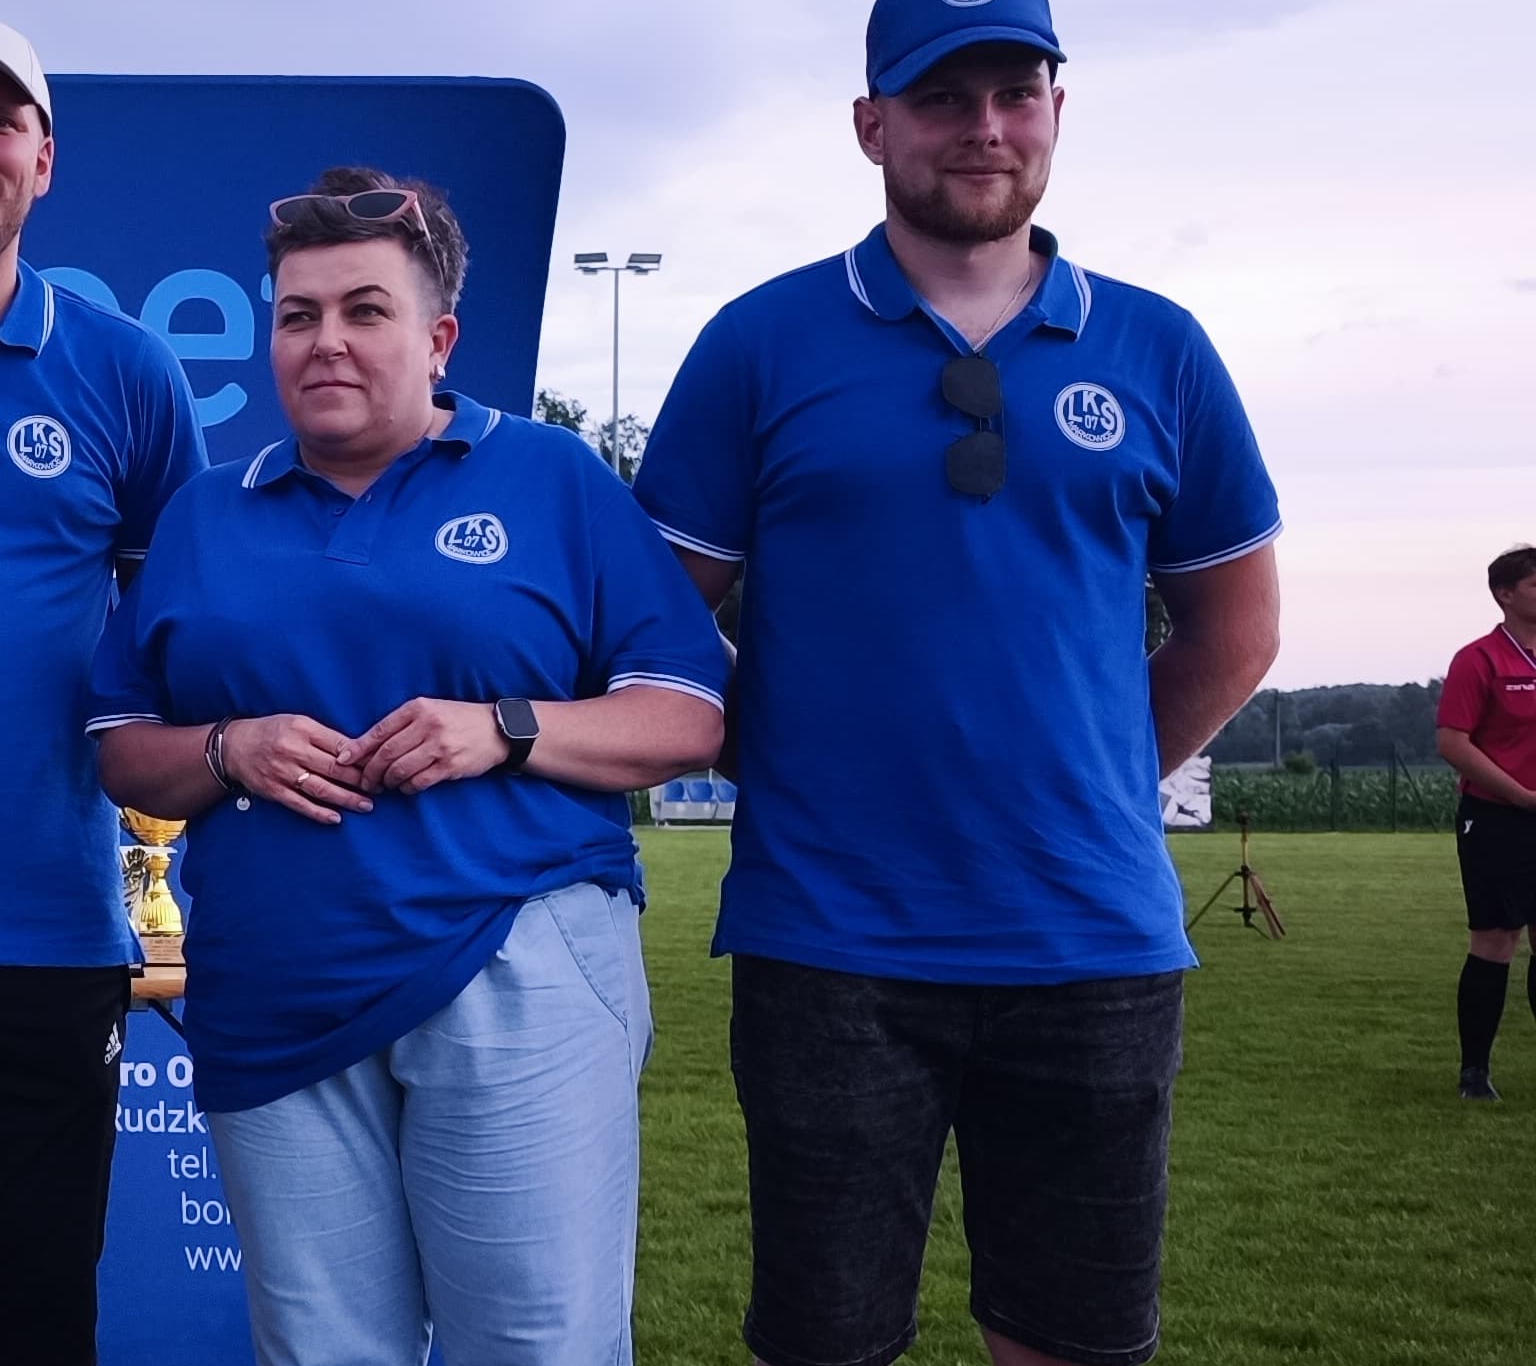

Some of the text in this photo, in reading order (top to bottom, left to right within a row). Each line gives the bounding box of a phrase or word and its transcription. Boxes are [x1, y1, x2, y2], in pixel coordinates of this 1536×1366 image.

[1068, 390, 1115, 431] LKS
[1084, 414, 1099, 431] 07
[19, 422, 62, 457] LKS
[34, 442, 48, 459] 07
[448, 519, 499, 550] LKS
[464, 535, 481, 548] 07
[119, 1061, 157, 1087] ro
[167, 1146, 217, 1180] tel.
[181, 1190, 231, 1226] bo
[184, 1245, 242, 1272] ww
